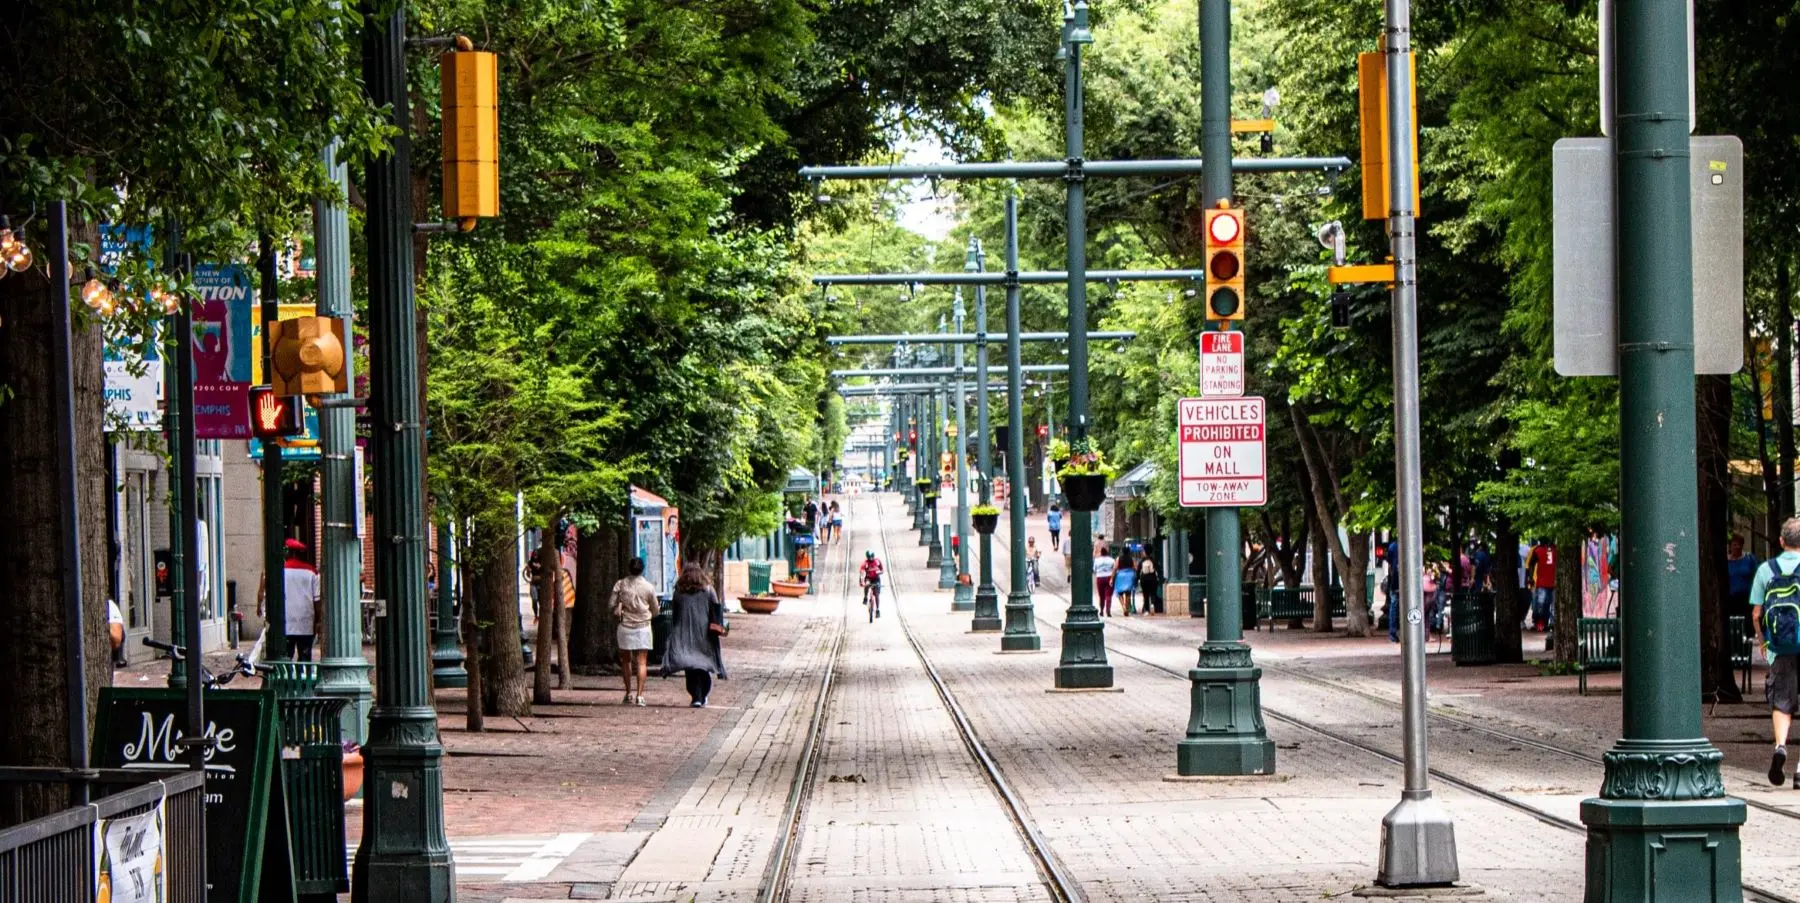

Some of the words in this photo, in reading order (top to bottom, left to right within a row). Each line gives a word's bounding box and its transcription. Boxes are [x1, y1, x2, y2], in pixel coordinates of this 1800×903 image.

[1212, 334, 1232, 343] FIRE
[1211, 343, 1233, 353] LANE
[1216, 355, 1228, 365] NO
[1205, 365, 1239, 375] PARKING
[1204, 379, 1241, 390] STANDING
[1185, 405, 1259, 421] VEHICLES
[1183, 425, 1260, 441] PROHIBITED
[1213, 445, 1232, 459] ON
[1205, 461, 1240, 475] MALL
[1197, 482, 1250, 492] TOW-AWAY
[1209, 492, 1237, 502] ZONE
